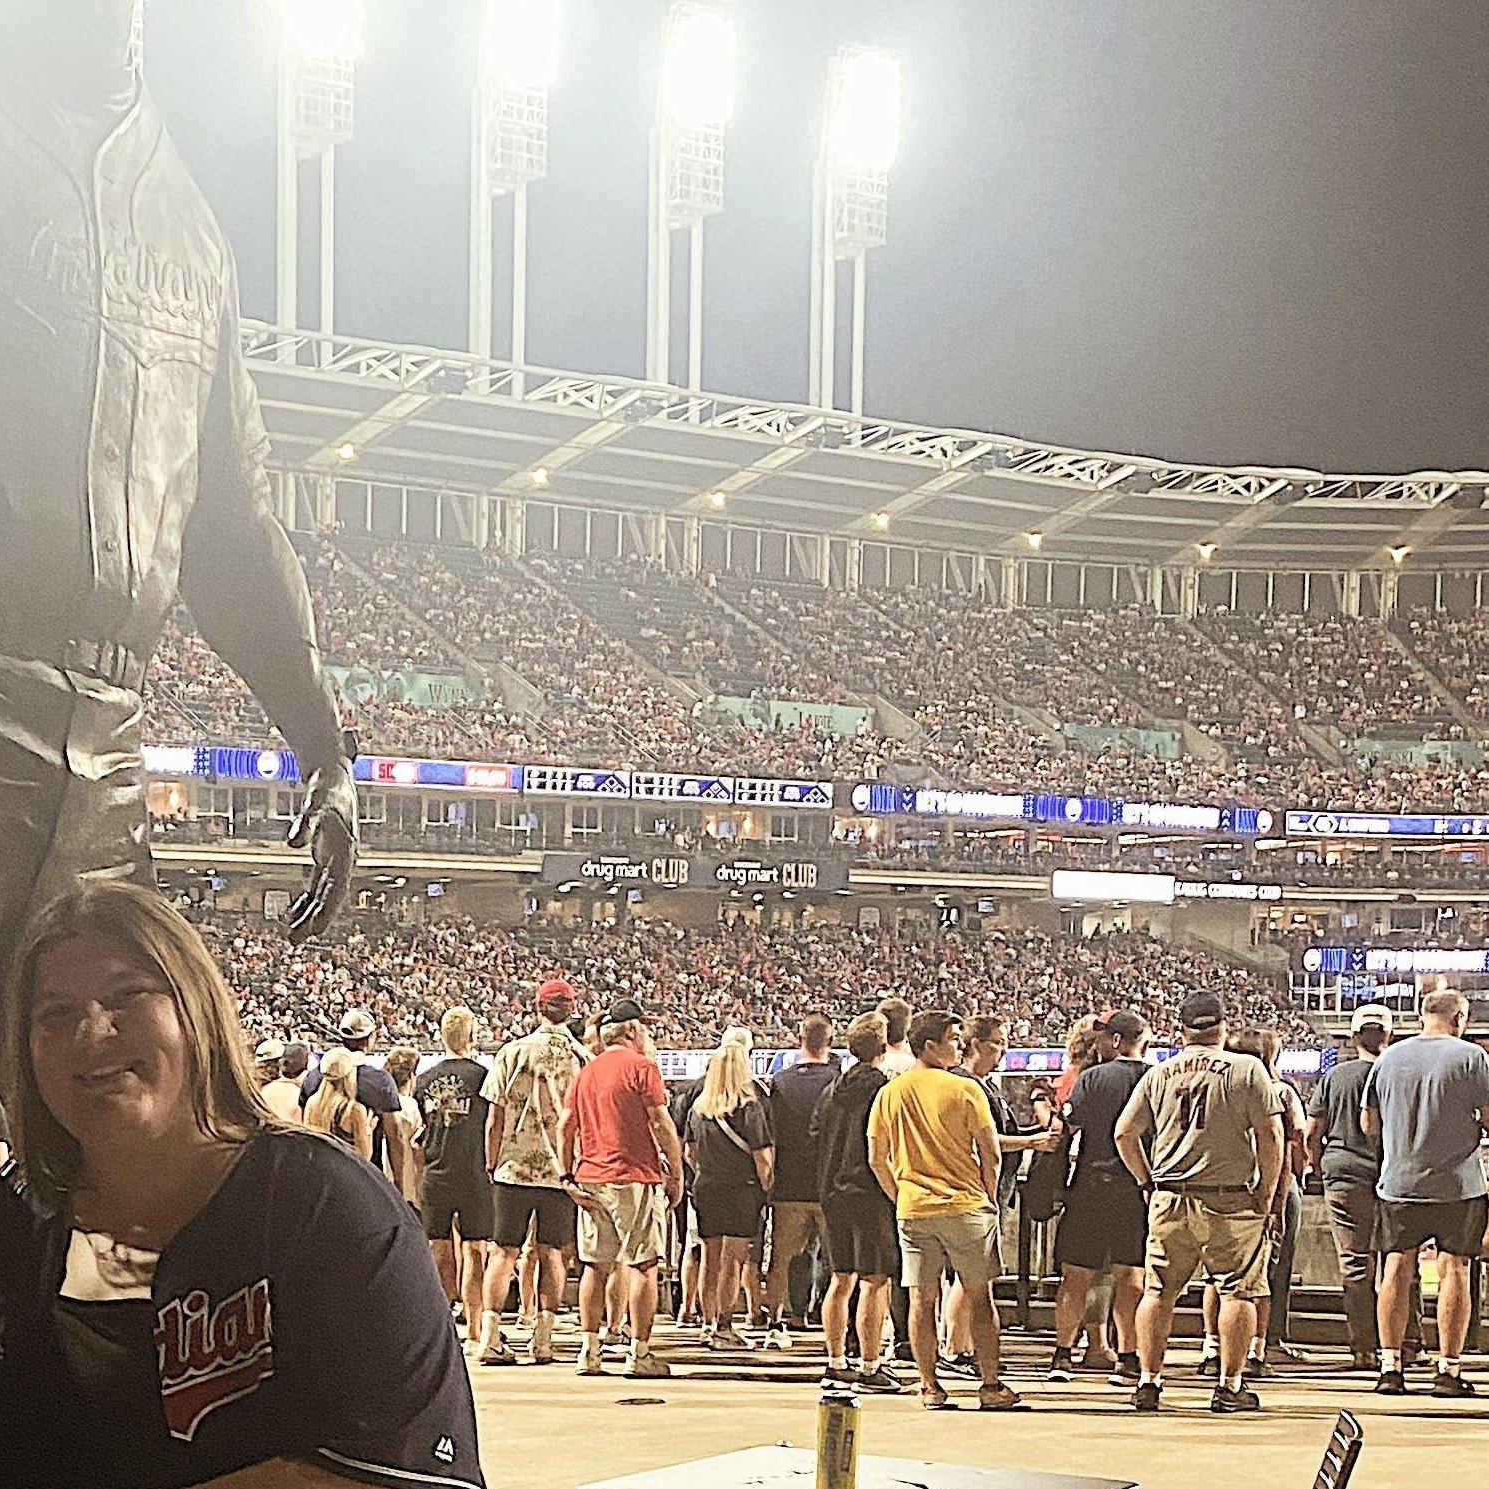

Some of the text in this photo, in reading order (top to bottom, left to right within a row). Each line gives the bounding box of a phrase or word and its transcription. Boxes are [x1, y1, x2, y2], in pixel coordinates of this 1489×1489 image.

[581, 858, 689, 883] drug mart CLUB
[715, 863, 818, 887] drug mart CLUB
[1175, 1082, 1209, 1130] 11
